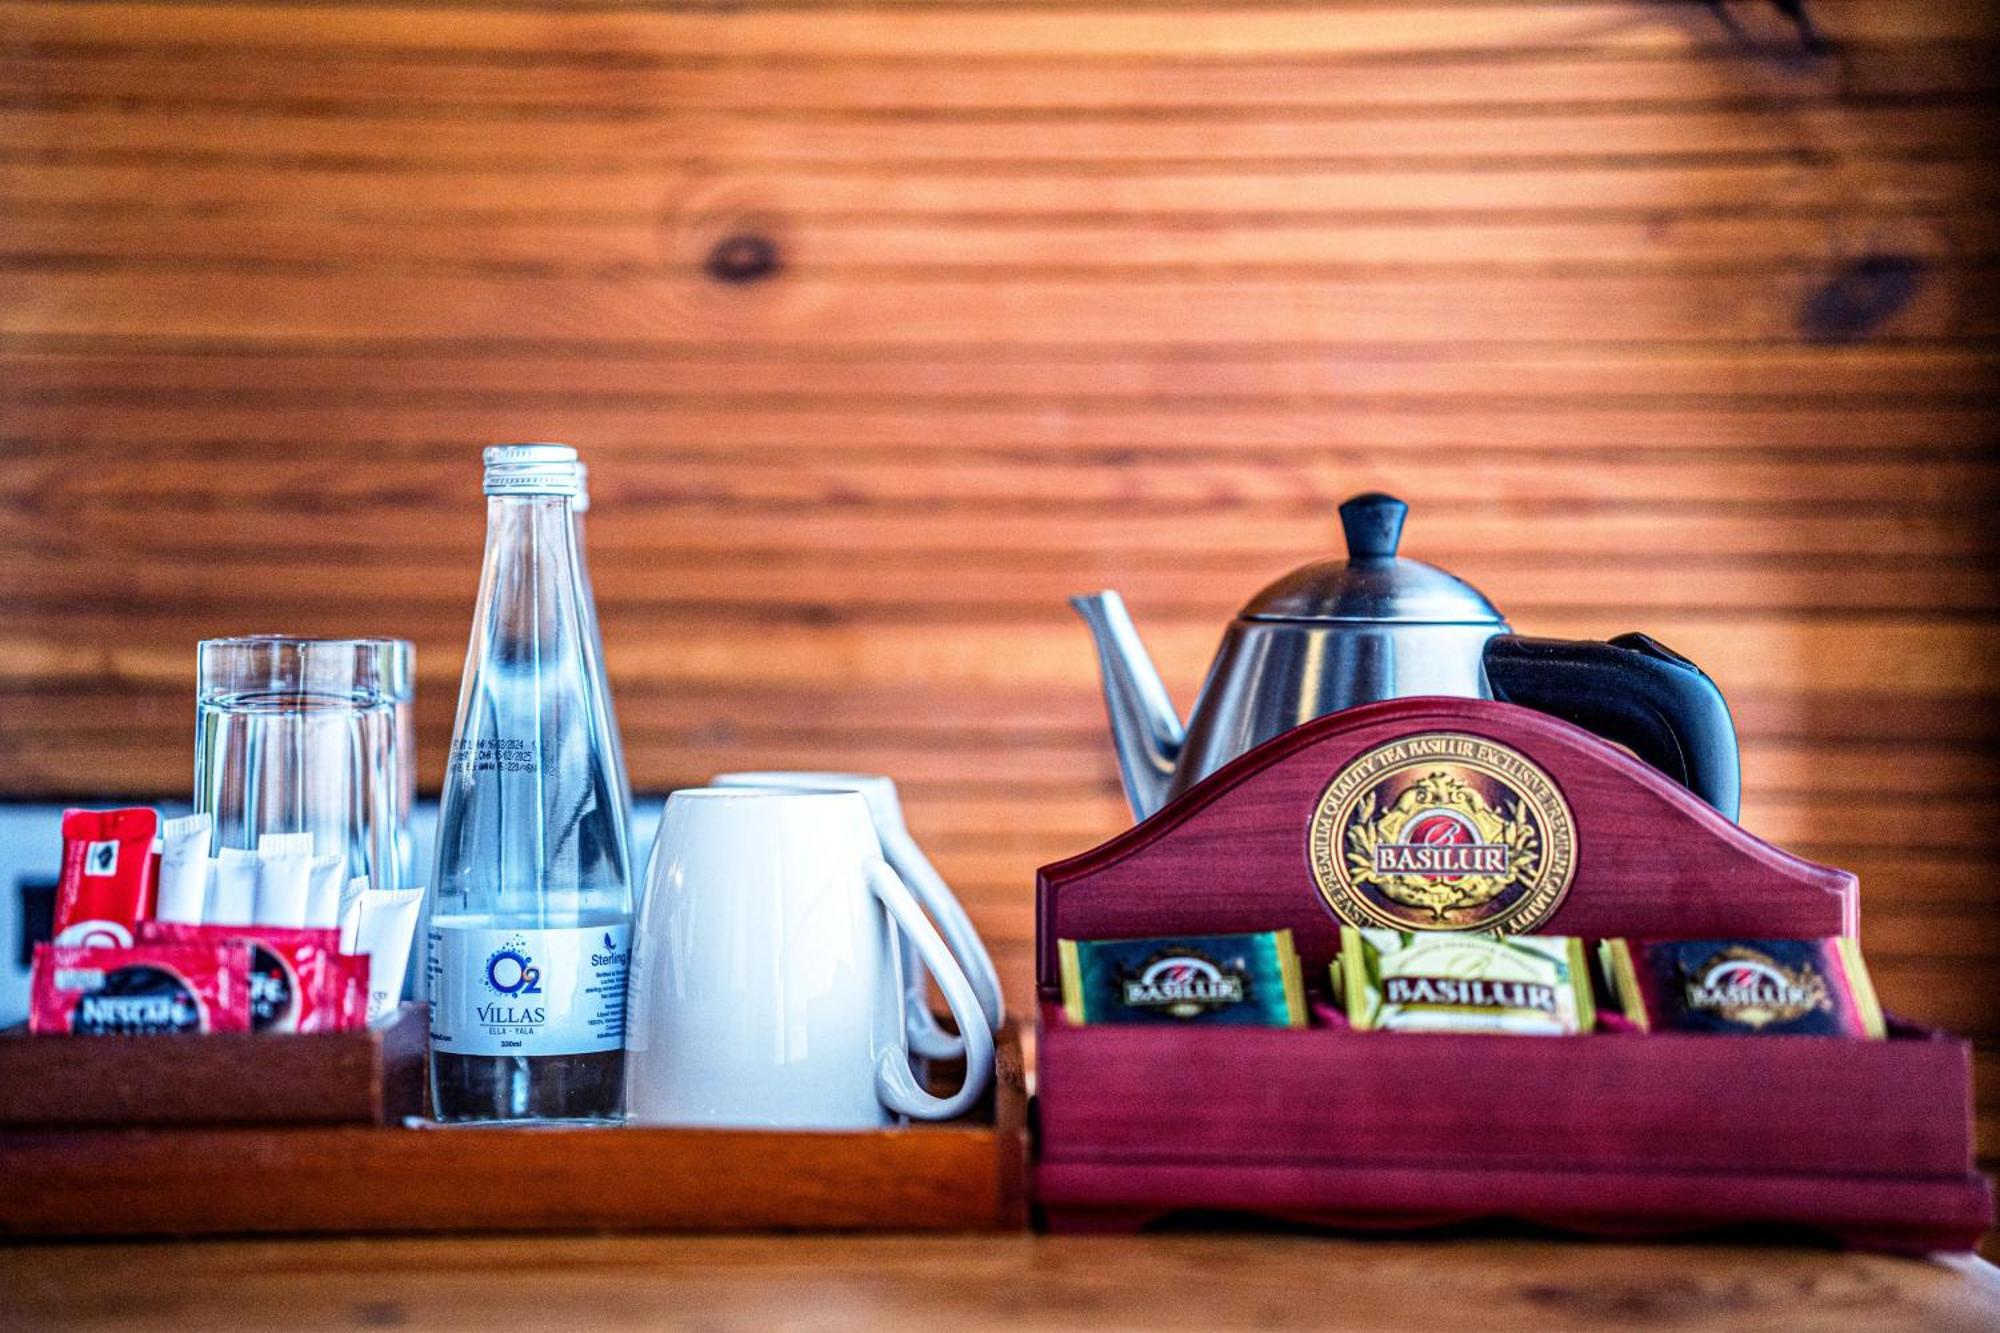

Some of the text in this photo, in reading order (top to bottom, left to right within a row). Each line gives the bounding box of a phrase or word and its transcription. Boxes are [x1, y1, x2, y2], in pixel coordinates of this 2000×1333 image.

[1377, 745, 1407, 766] TEA
[1408, 739, 1473, 757] BASILUR
[1324, 758, 1377, 815] QUALITY
[1316, 820, 1339, 892] PREMIUM
[1379, 848, 1505, 871] BASILUR
[1128, 979, 1238, 1001] BASILUR
[1387, 979, 1556, 1012] BASILUR
[476, 1002, 545, 1023] VILLAS
[489, 1027, 506, 1035] ELLA
[515, 1027, 534, 1035] YALA
